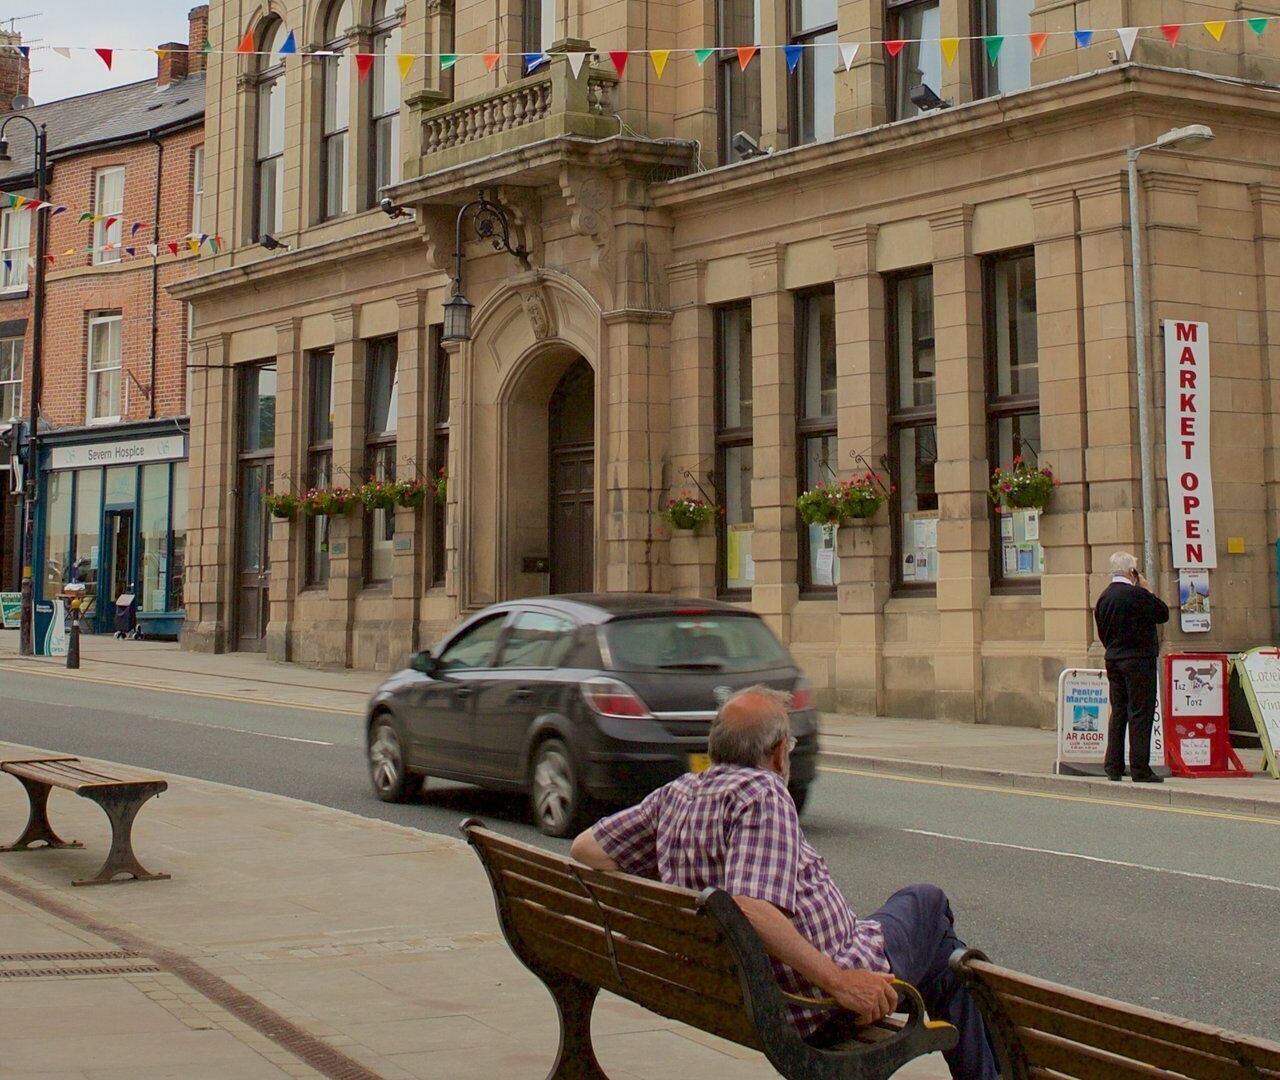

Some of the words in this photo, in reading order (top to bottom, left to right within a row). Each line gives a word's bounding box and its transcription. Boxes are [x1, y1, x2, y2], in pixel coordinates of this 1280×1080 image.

[1176, 322, 1198, 460] MARKET
[88, 448, 112, 461] Severn
[115, 445, 145, 459] Hospice
[1181, 472, 1204, 563] OPEN
[1066, 695, 1108, 703] Marchnad
[1066, 732, 1078, 741] AR
[1080, 732, 1104, 741] AGOR
